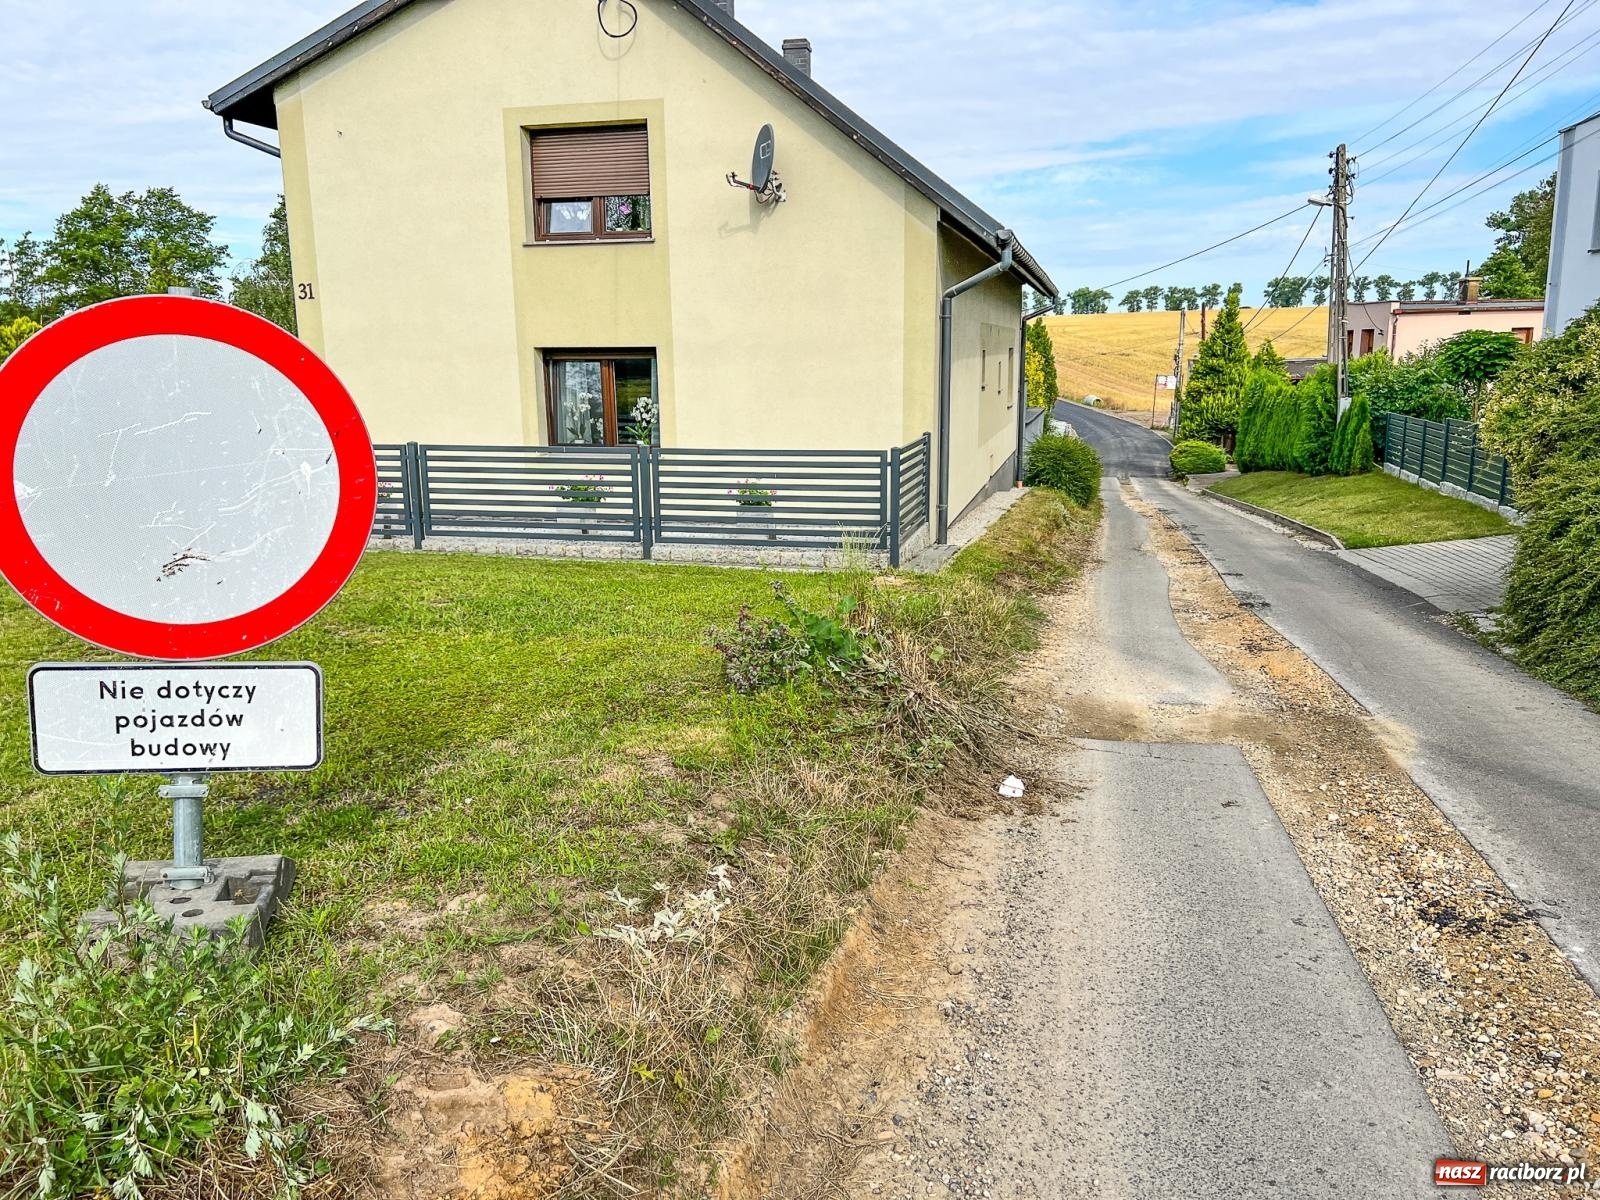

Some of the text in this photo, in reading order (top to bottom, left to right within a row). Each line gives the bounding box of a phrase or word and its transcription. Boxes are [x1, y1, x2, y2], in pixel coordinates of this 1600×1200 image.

[298, 283, 315, 300] 31
[99, 680, 257, 704] Nie dotyczy
[115, 708, 244, 734] pojazdów
[130, 737, 231, 760] budowy
